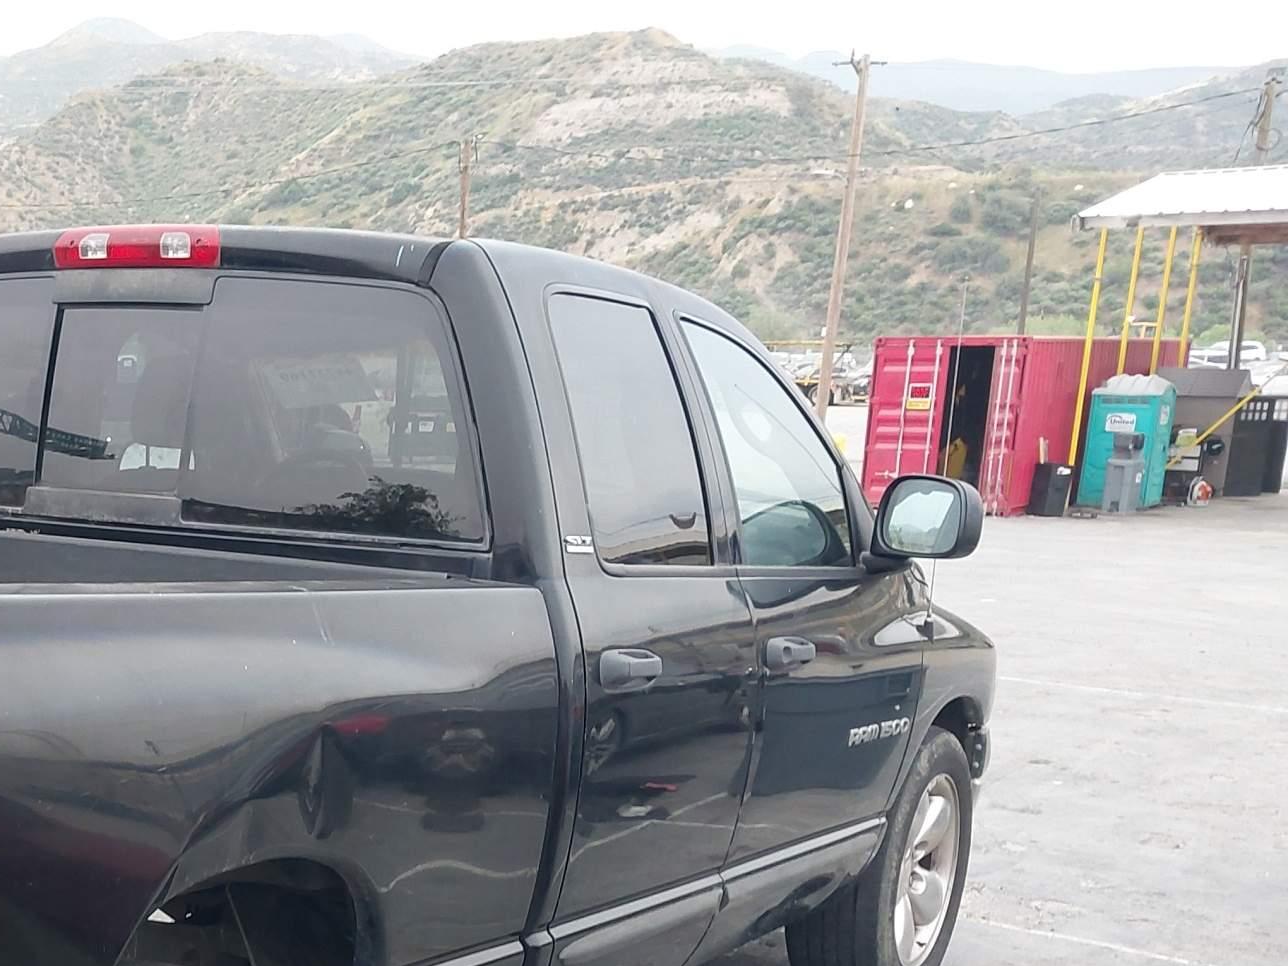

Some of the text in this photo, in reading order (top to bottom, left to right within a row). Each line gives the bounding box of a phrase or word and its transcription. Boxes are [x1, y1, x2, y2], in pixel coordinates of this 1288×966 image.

[1110, 417, 1135, 425] United
[848, 717, 910, 747] RAM 1500
